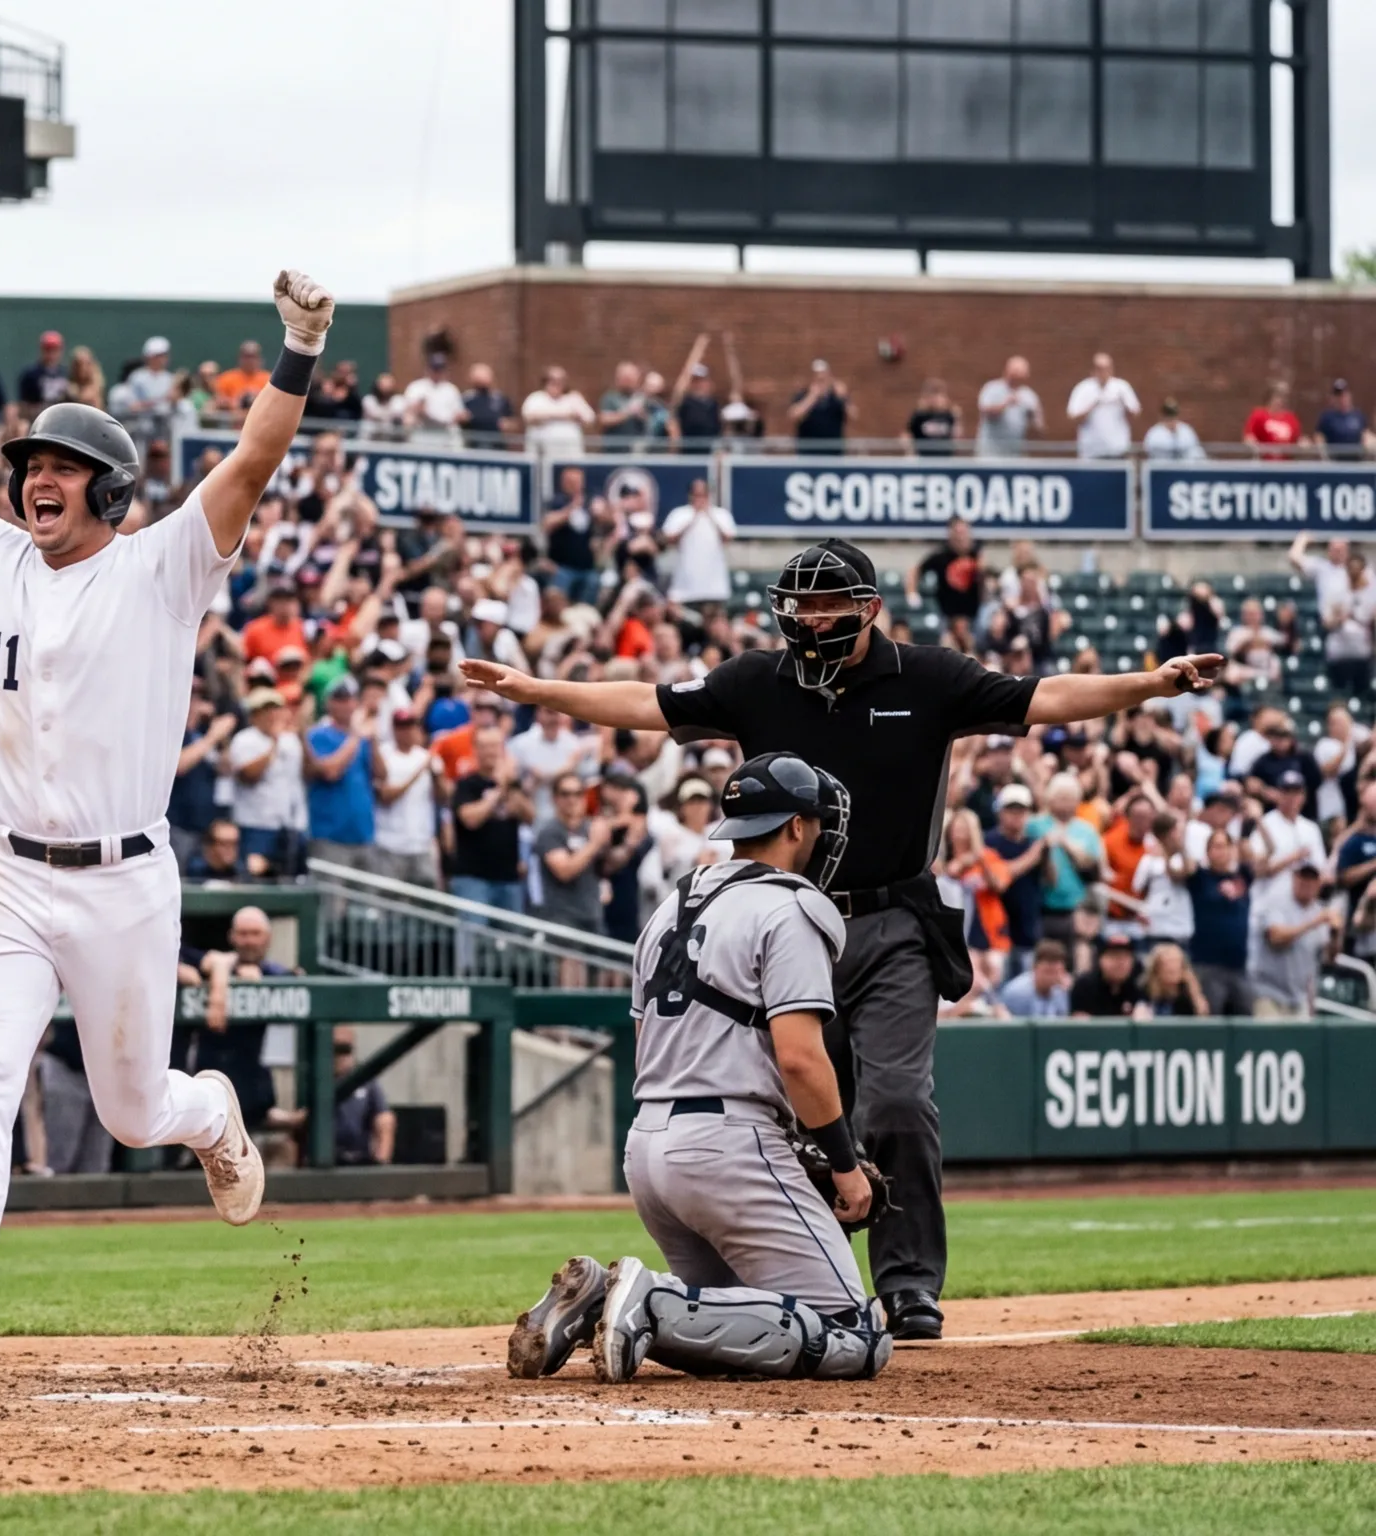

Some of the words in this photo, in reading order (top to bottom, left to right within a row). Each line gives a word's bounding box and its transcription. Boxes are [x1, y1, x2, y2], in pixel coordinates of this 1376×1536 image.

[375, 457, 521, 514] STADIUM
[785, 472, 1072, 523] SCOREBOARD
[1168, 481, 1308, 520] SECTION
[1044, 1049, 1225, 1128] SECTION
[1235, 1050, 1305, 1125] 108
